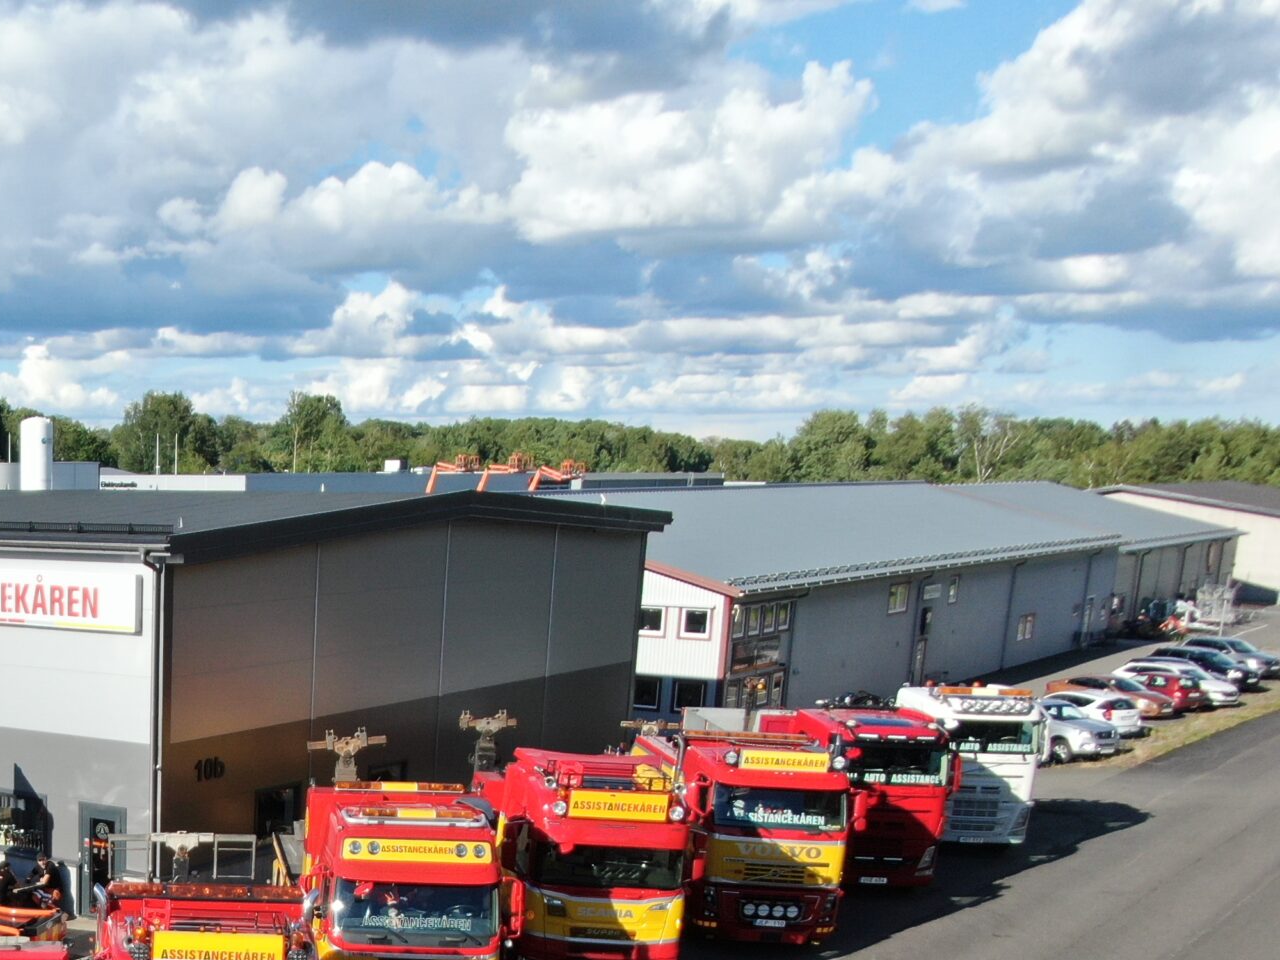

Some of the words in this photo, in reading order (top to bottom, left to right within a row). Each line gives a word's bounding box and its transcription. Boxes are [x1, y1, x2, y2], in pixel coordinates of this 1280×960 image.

[959, 742, 980, 751] AUTO
[987, 743, 1032, 752] ASSISTANCE
[743, 756, 826, 768] ASSISTANCEKÅREN
[194, 756, 225, 782] 10b
[864, 773, 886, 782] AUTO
[891, 774, 940, 784] ASSISTANCE
[572, 801, 666, 814] ASSISTANCEKÅREN
[747, 812, 825, 826] SISTANCEKÅREN
[380, 844, 454, 855] ASSISTANCEKÅREN
[735, 842, 822, 859] VOLVO
[577, 906, 634, 919] SCANIA
